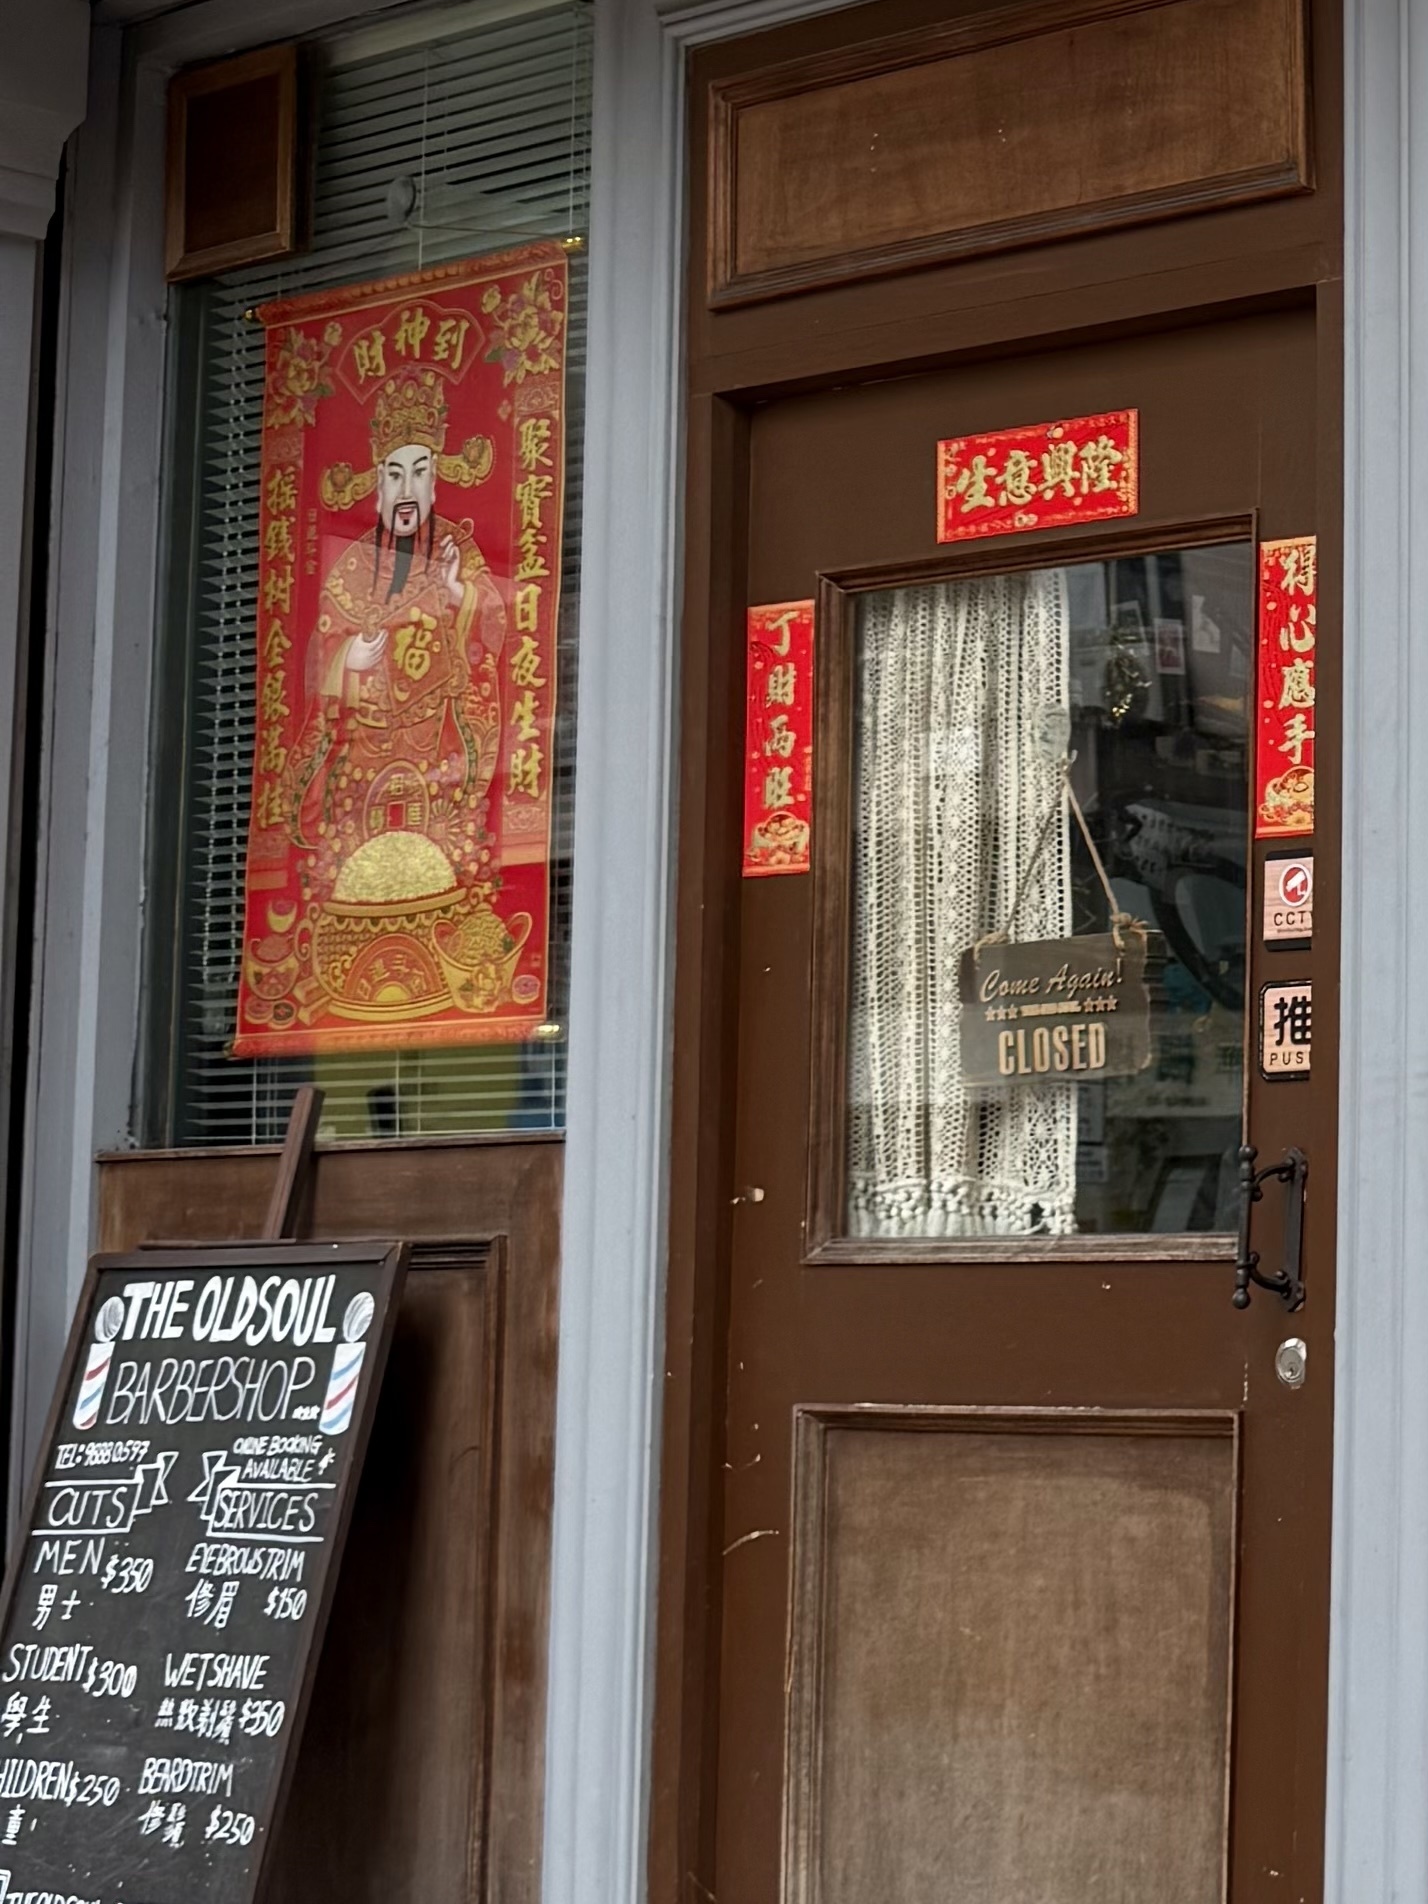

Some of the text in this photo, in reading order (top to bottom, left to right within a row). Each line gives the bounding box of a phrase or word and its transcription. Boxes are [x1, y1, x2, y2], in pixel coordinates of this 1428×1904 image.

[353, 306, 470, 385] 財神到
[956, 434, 1124, 514] 生意興隆
[392, 606, 437, 684] 福
[1278, 545, 1317, 766] 得心應手
[1274, 910, 1313, 928] CCT
[979, 957, 1124, 1003] Come Again!
[1273, 995, 1312, 1047] 推
[998, 1022, 1107, 1076] CLOSED
[1269, 1051, 1311, 1067] PUS
[122, 1280, 195, 1341] THE
[105, 1356, 316, 1425] BARBERSHOP
[241, 1457, 317, 1483] AVAILABLE
[47, 1486, 129, 1528] CUTS
[213, 1489, 320, 1533] SERVICES
[33, 1536, 155, 1594] MEN $350
[31, 1583, 82, 1631] 男士
[184, 1577, 309, 1629] 修眉 $150
[1, 1643, 138, 1698] STUDENT $300
[0, 1692, 51, 1741] 學生
[237, 1696, 286, 1738] $350
[64, 1771, 121, 1807] $250
[204, 1803, 256, 1846] $250
